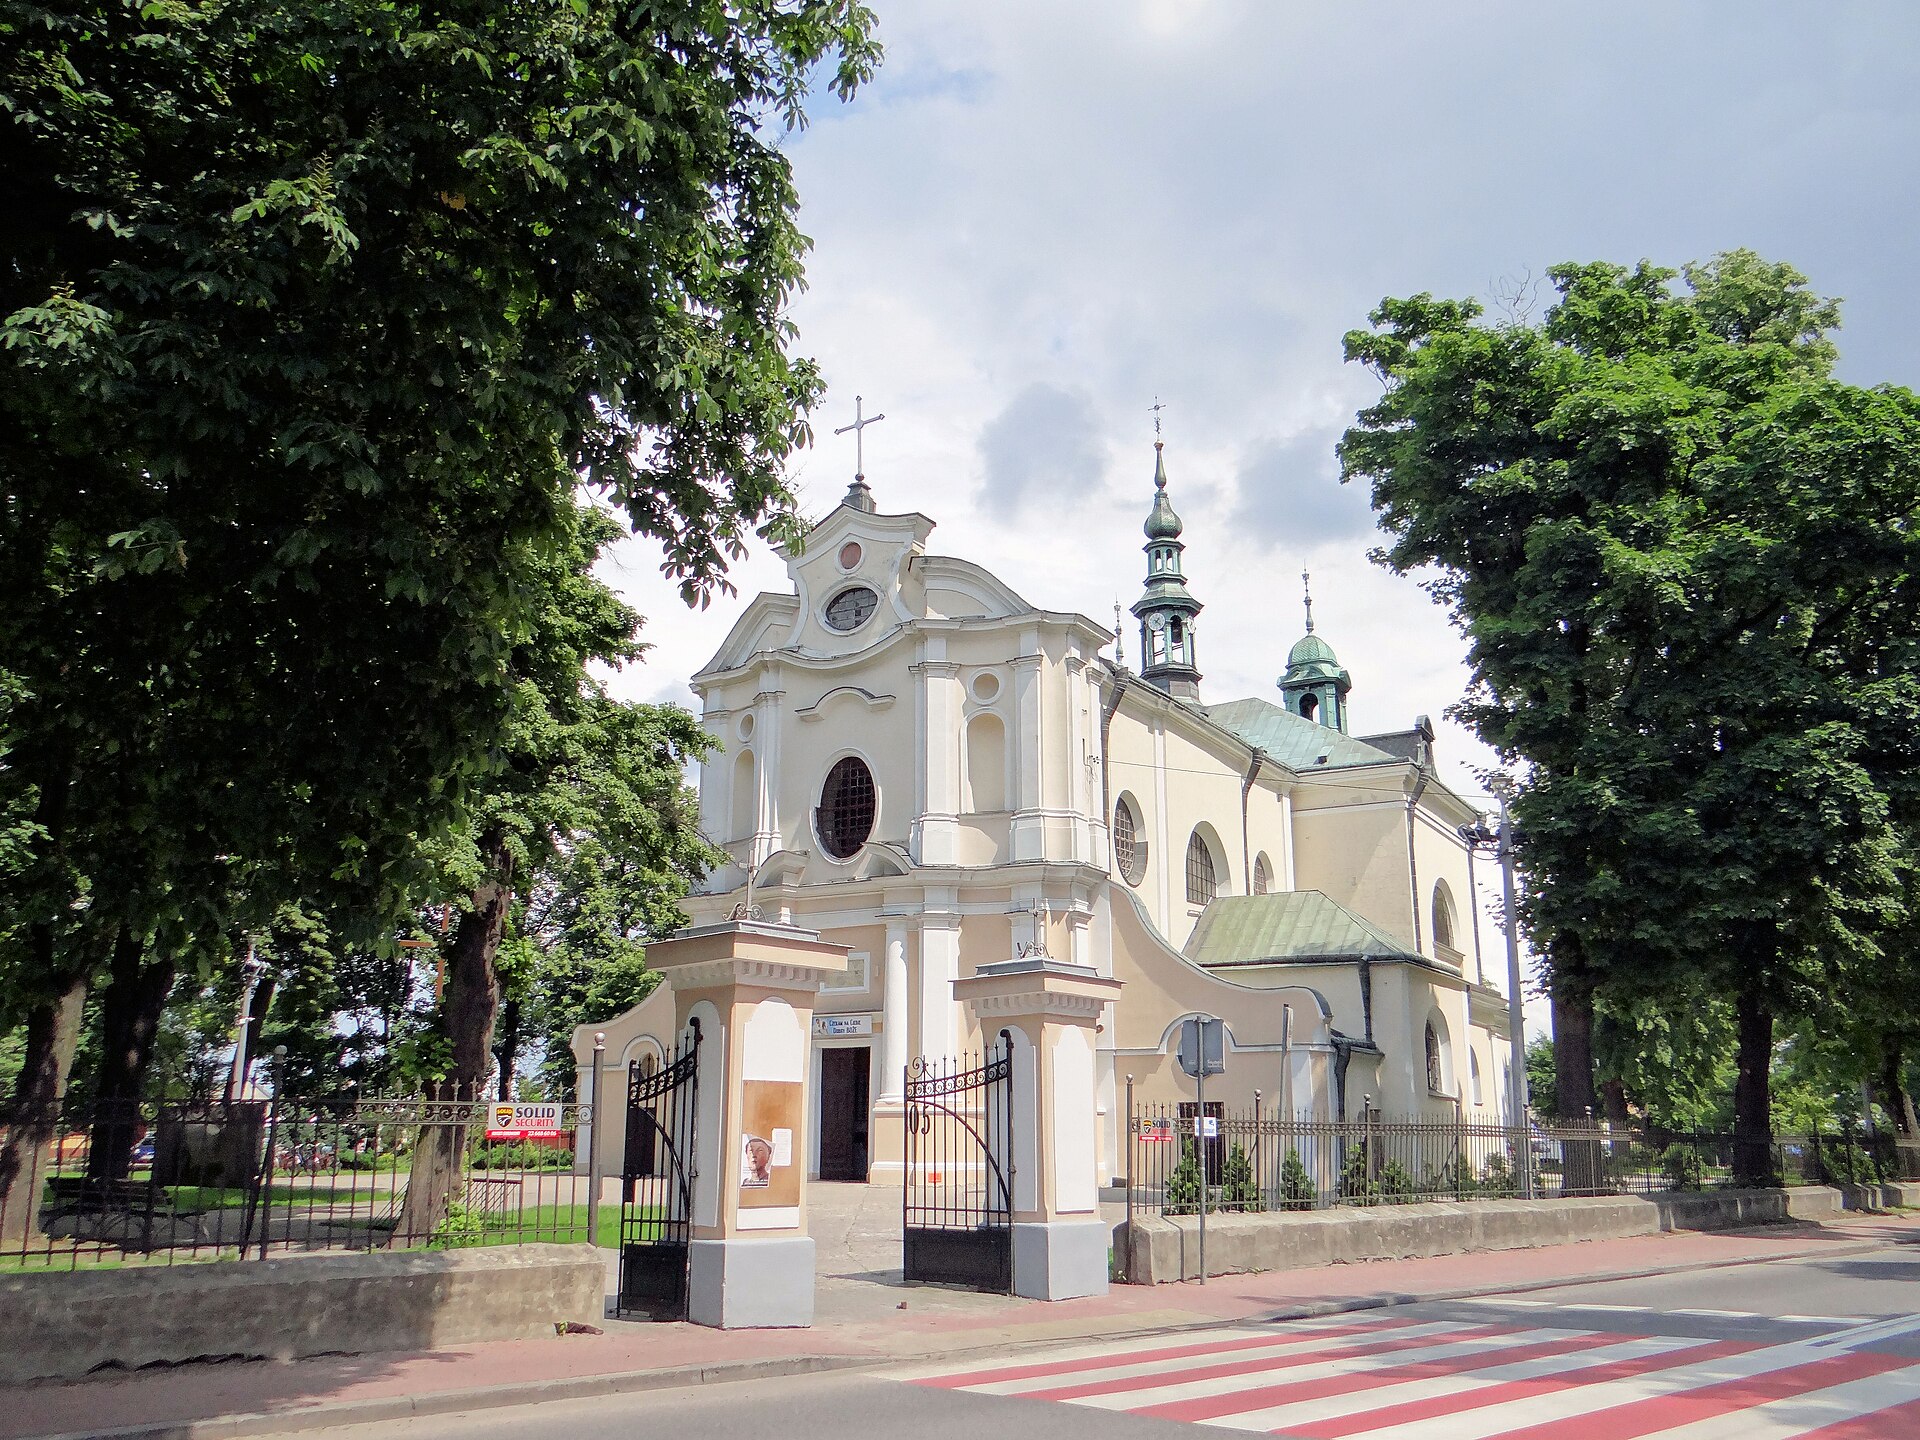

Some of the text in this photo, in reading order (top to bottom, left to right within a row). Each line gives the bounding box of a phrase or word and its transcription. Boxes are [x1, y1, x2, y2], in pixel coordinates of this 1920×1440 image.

[516, 1107, 555, 1118] SOLID
[515, 1119, 555, 1127] SECURITY
[1152, 1120, 1170, 1128] SOLID
